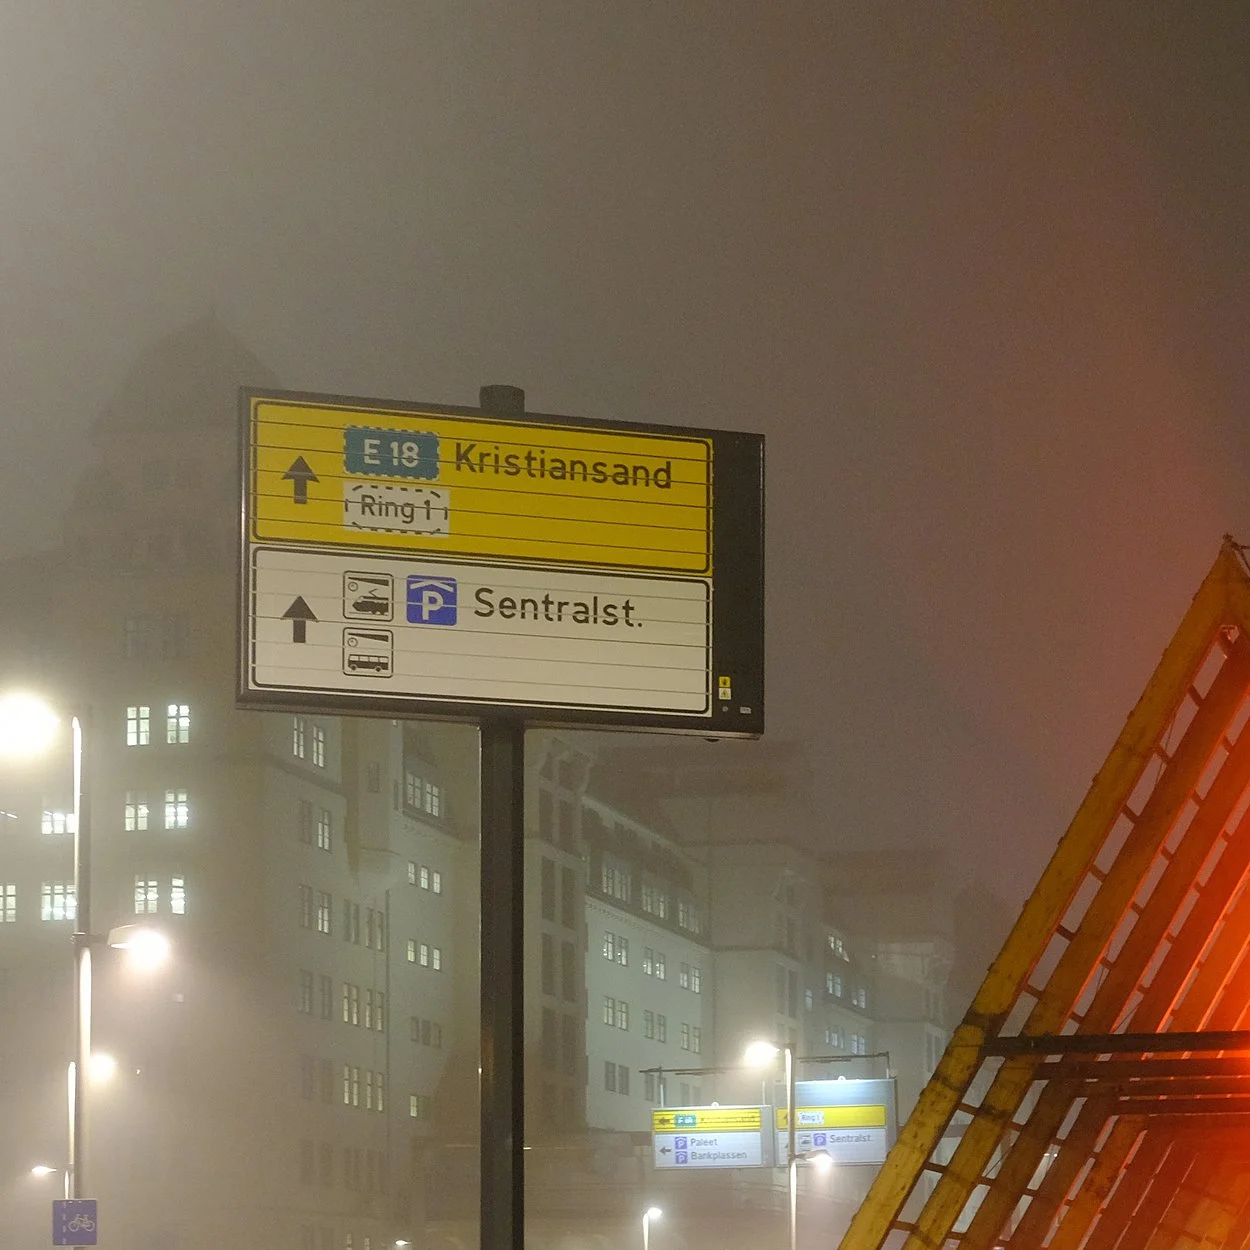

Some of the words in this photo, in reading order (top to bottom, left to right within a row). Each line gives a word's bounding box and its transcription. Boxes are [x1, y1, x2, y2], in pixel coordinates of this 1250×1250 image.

[363, 438, 381, 465] E
[389, 441, 420, 468] 18
[455, 442, 672, 489] Kristiansand
[360, 494, 415, 525] Ring
[423, 499, 431, 521] 1
[421, 590, 444, 620] P
[473, 587, 643, 628] Sentralst.
[801, 1114, 816, 1122] Ring
[691, 1151, 747, 1162] Bankplassen
